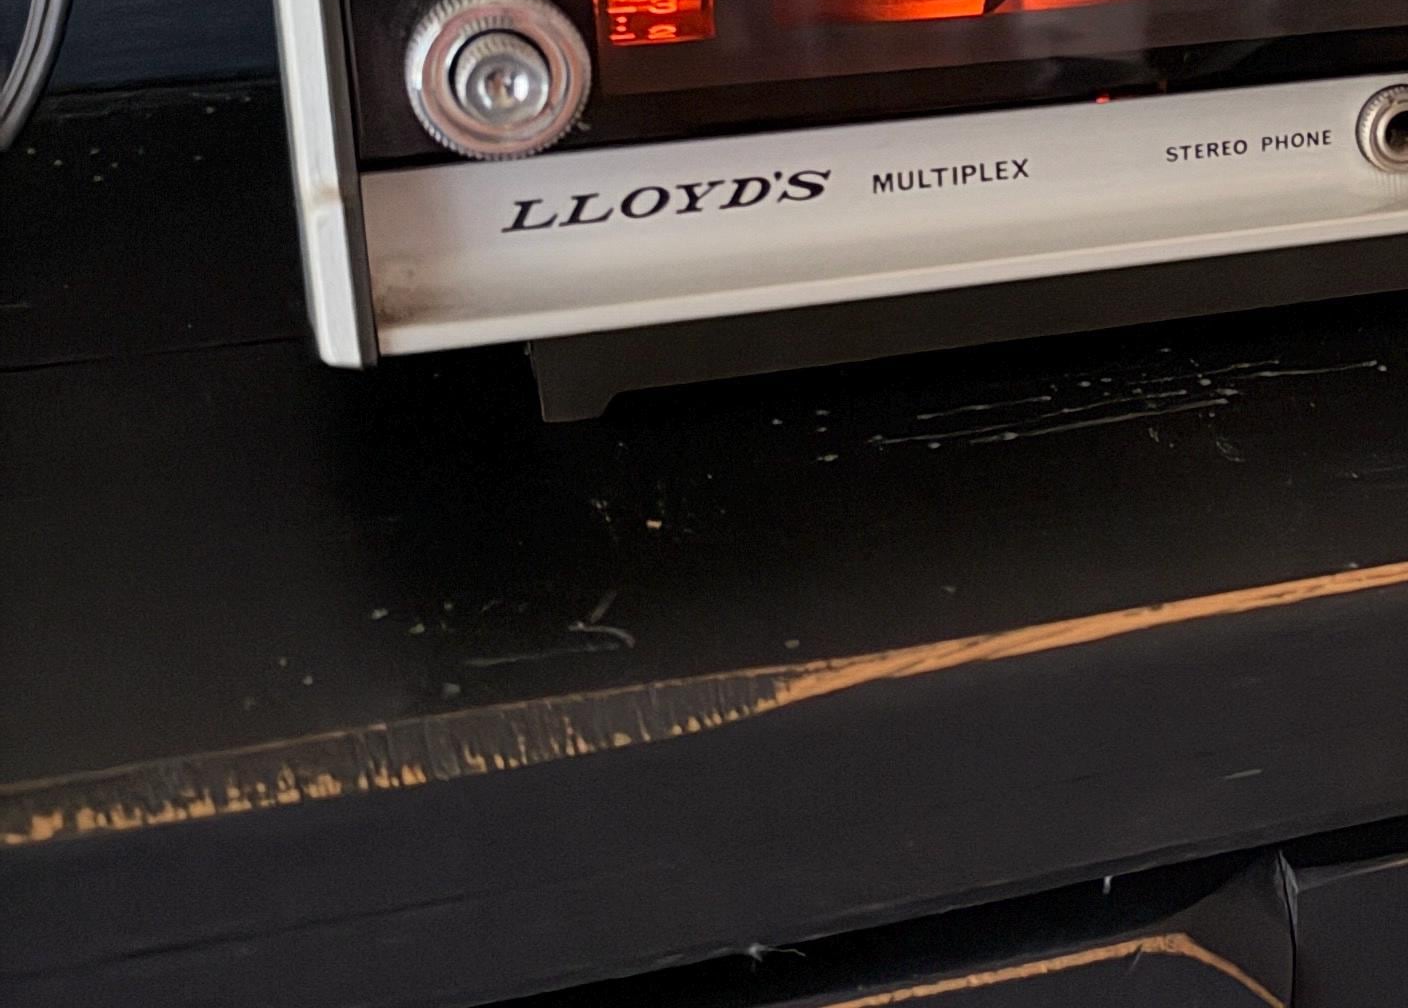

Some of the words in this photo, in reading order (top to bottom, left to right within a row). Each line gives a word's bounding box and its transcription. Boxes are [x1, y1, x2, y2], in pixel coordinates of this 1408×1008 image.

[1165, 139, 1248, 164] STEREO
[1261, 129, 1334, 153] PHONE
[872, 158, 1030, 195] MULTIPLEX
[501, 168, 831, 233] LLOYD'S
